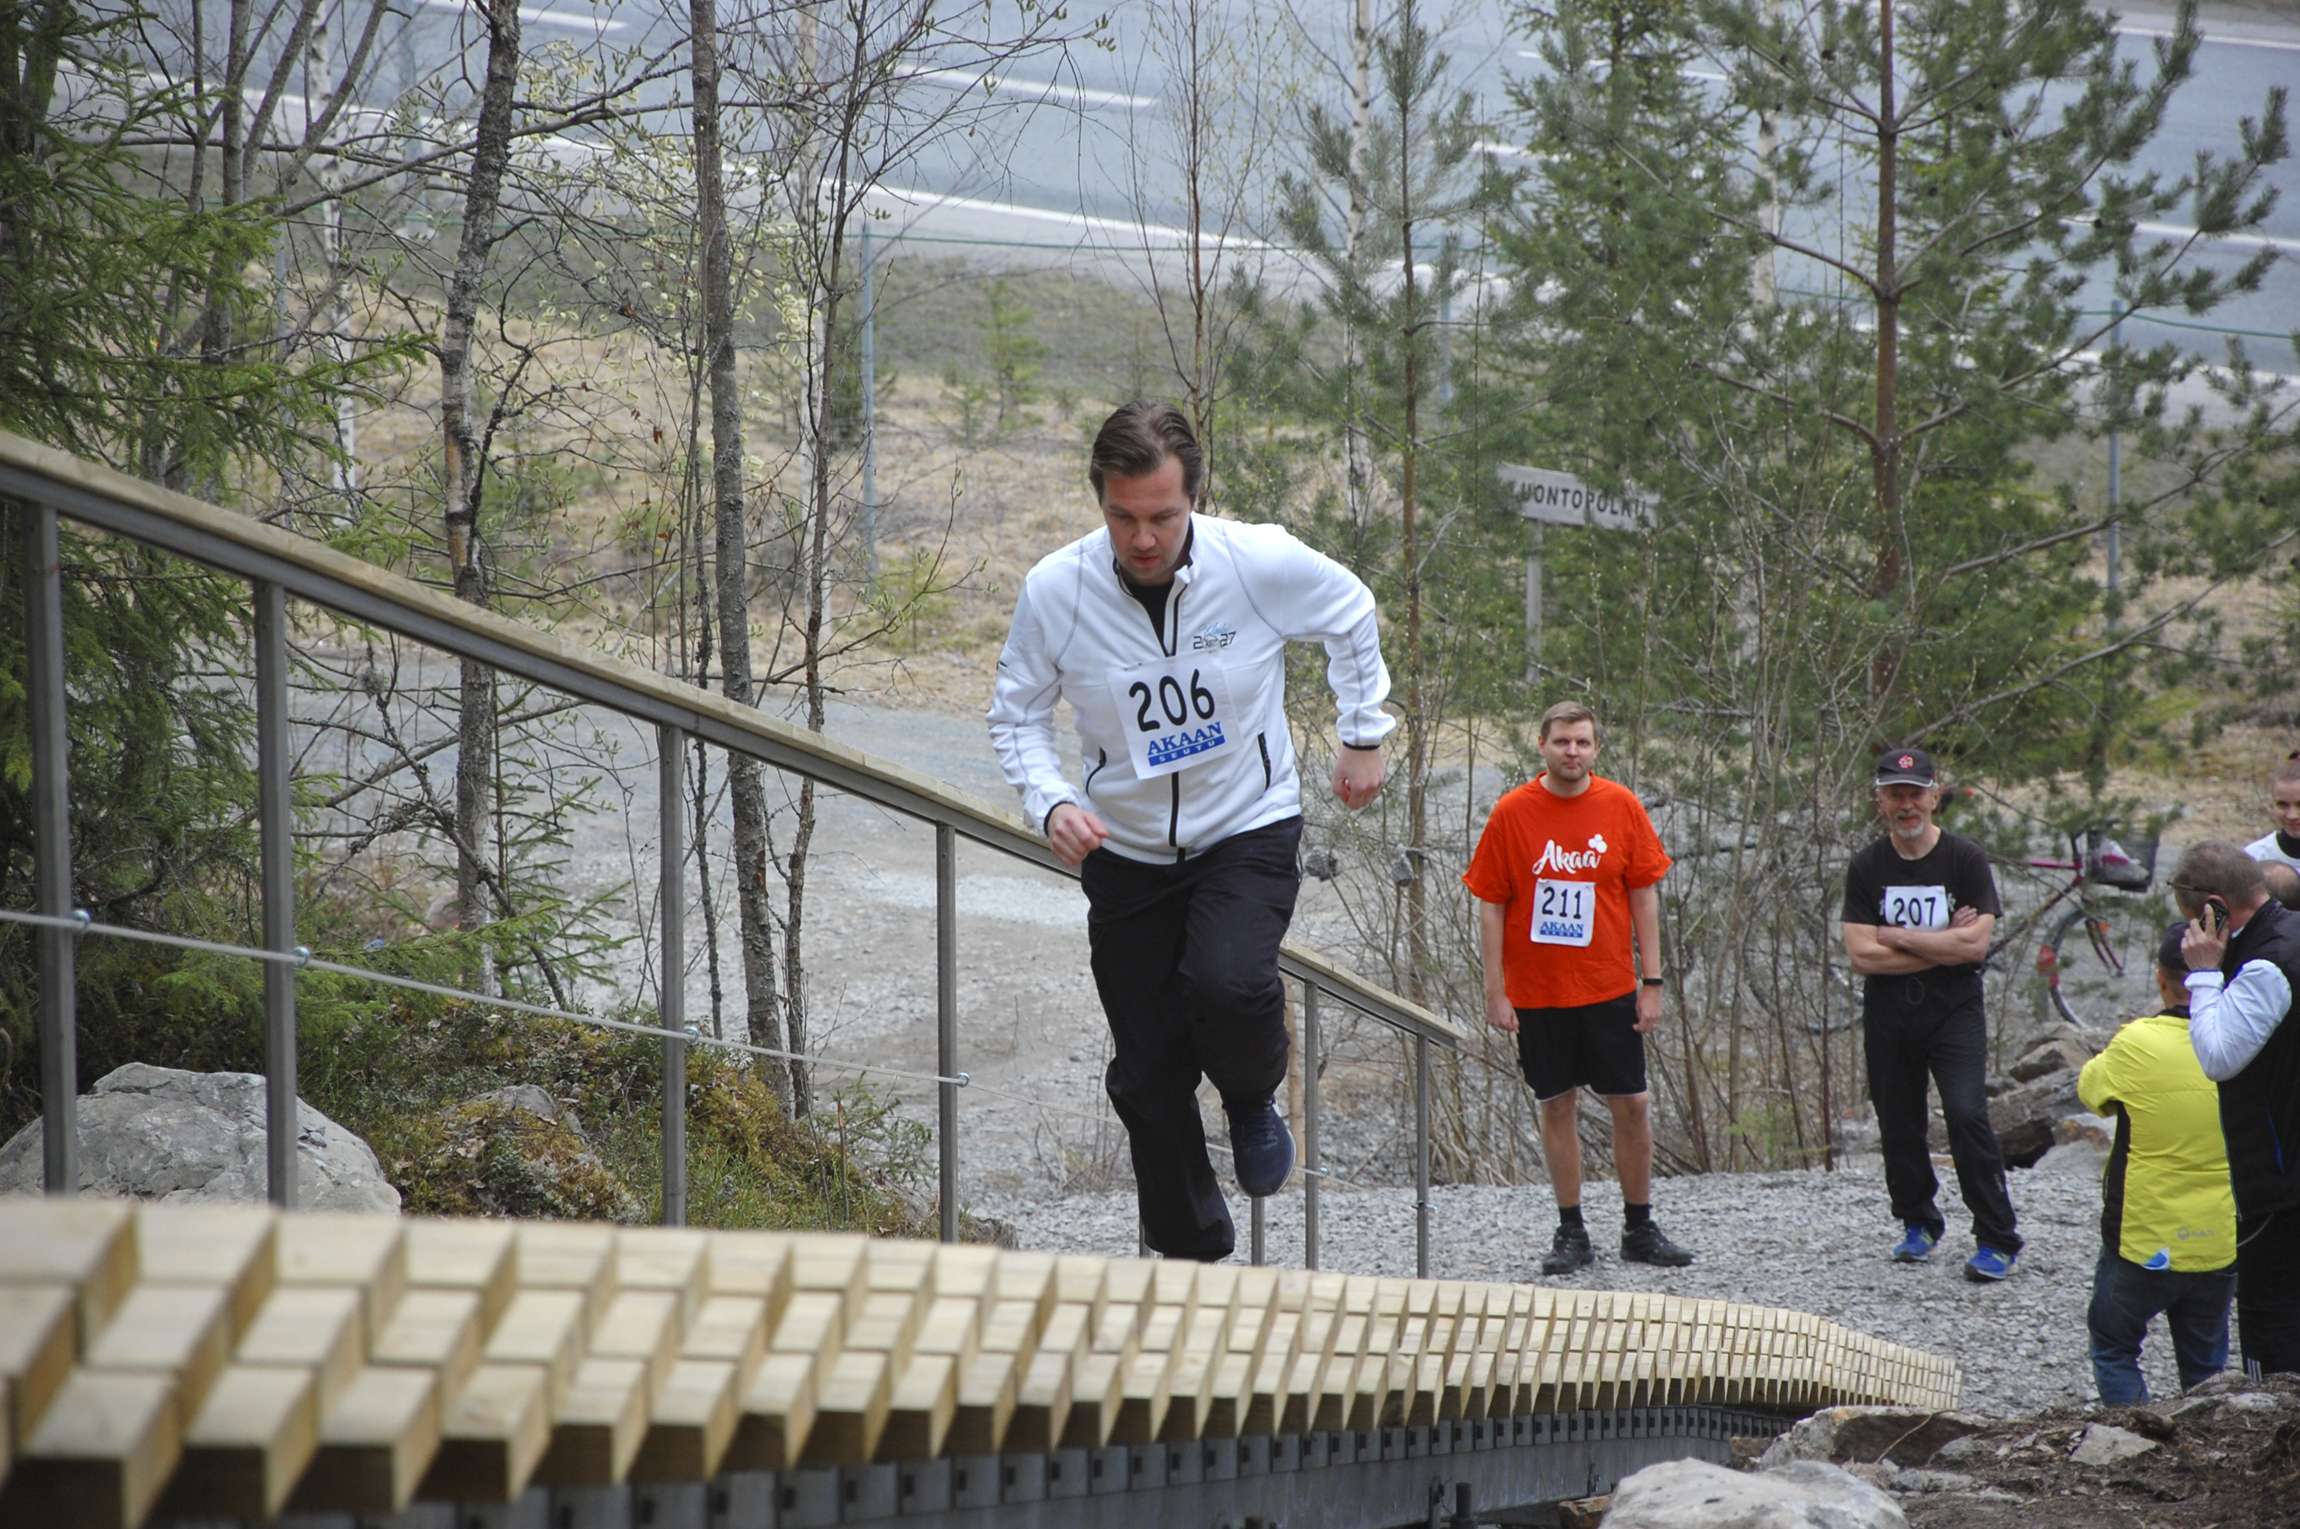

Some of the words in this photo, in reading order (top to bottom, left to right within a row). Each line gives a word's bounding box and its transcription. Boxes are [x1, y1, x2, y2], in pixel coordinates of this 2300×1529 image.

[1129, 668, 1215, 733] 206
[1147, 721, 1222, 757] AKAAN
[1158, 740, 1216, 763] SEUTU
[1532, 839, 1601, 875] Akaa
[1541, 886, 1582, 920] 211
[1893, 896, 1936, 928] 207
[1540, 921, 1585, 932] AKAAN
